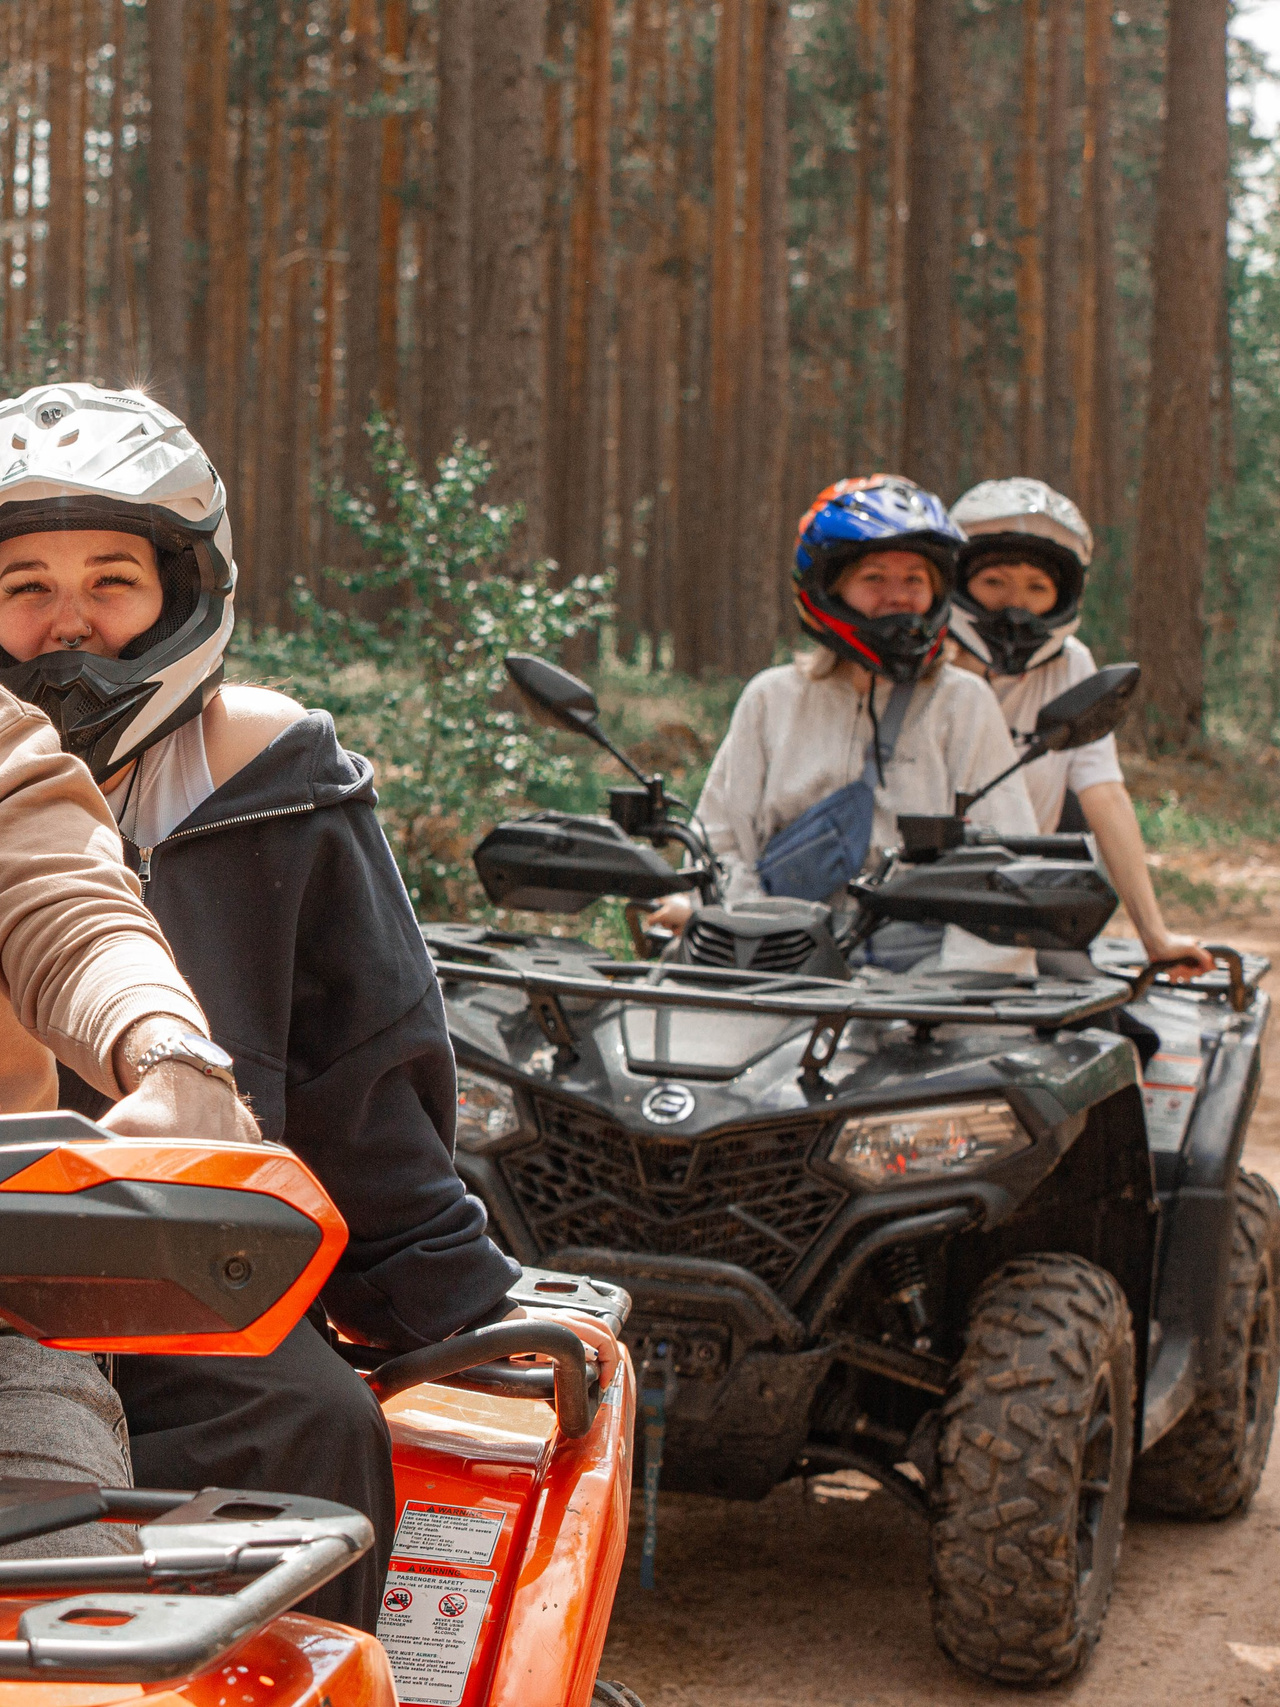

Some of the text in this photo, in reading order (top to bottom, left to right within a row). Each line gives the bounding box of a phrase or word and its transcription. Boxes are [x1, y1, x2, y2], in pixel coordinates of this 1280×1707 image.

[439, 1507, 482, 1518] WARNING
[419, 1566, 460, 1577] WARNING
[397, 1575, 436, 1584] PASSENGER
